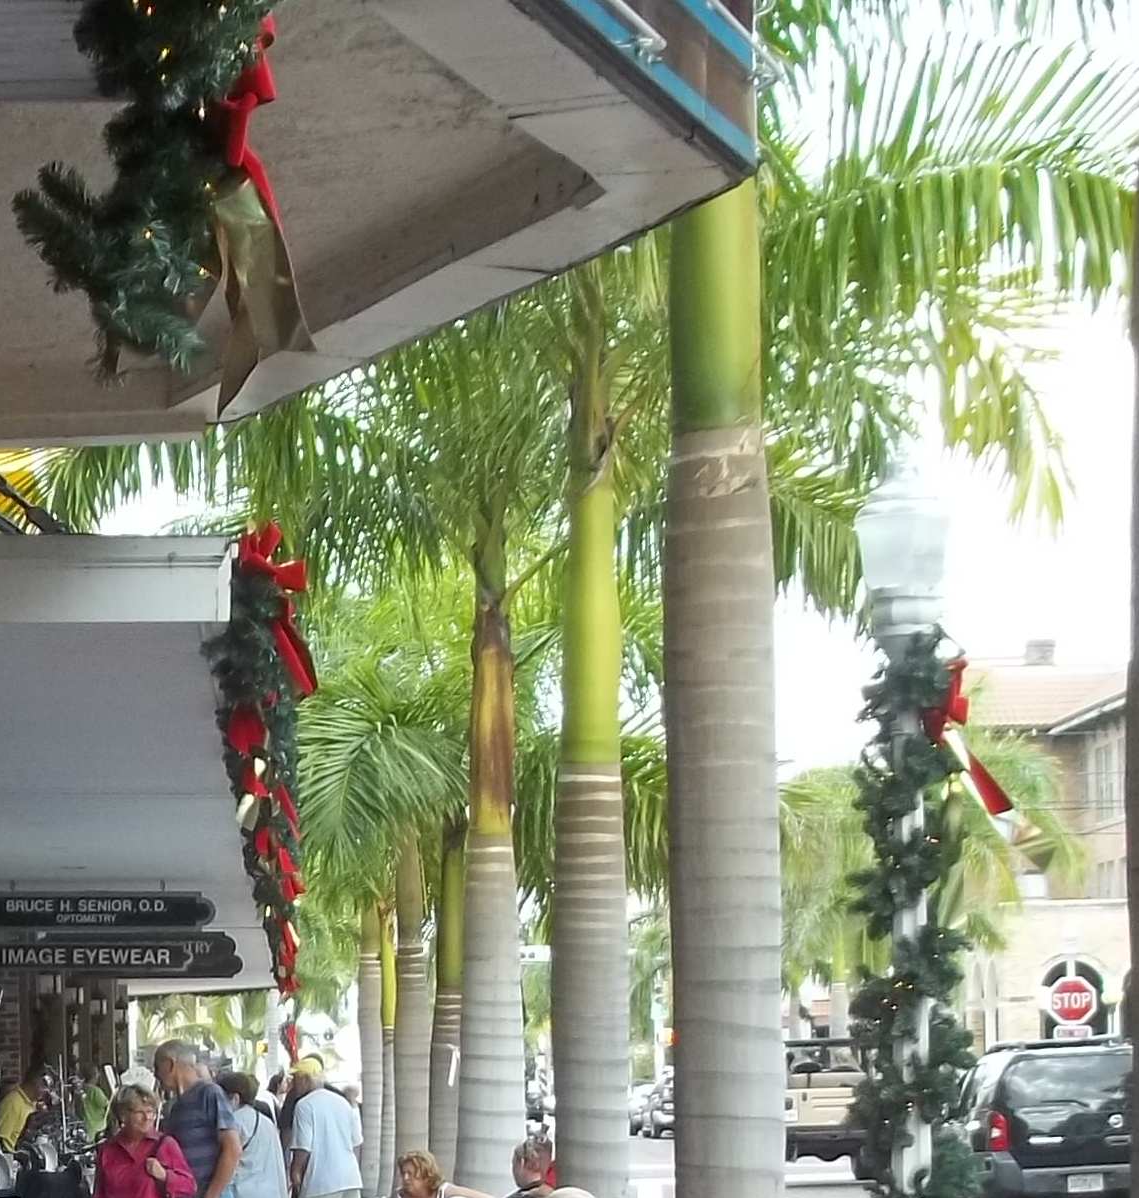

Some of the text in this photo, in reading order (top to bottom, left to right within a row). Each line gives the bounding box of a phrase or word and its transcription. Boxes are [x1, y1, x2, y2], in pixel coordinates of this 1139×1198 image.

[5, 900, 167, 914] BRUCE H. SENIOR, O.D.
[56, 914, 117, 923] OPTOMETRY
[1, 948, 170, 965] IMAGE EYEWEAR
[1051, 993, 1091, 1010] STOP
